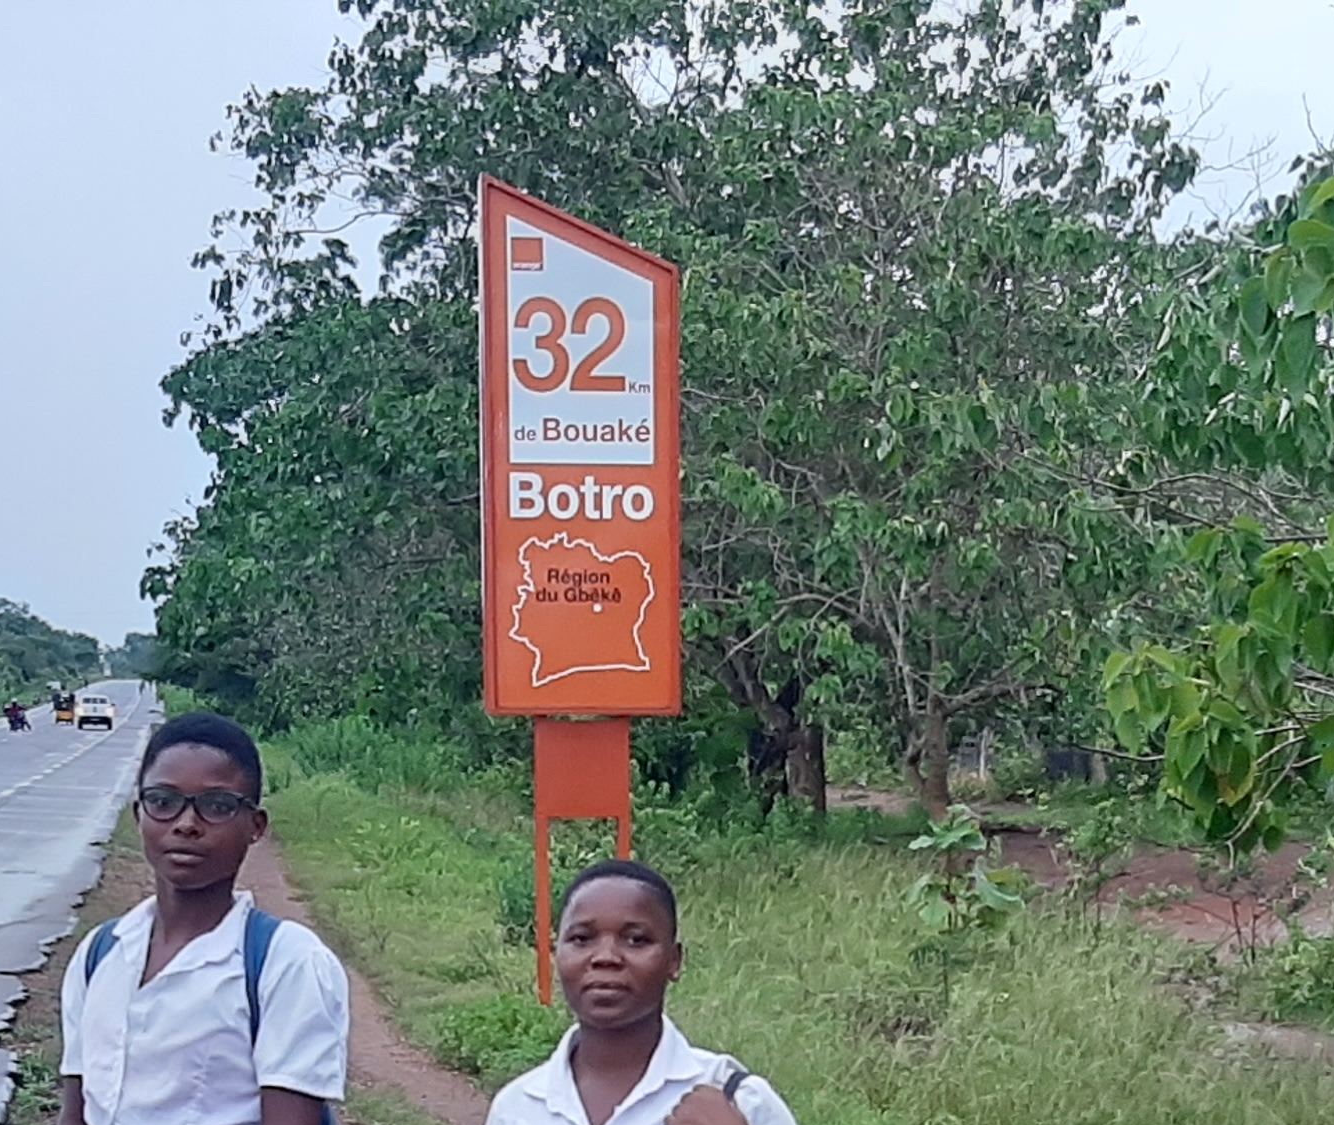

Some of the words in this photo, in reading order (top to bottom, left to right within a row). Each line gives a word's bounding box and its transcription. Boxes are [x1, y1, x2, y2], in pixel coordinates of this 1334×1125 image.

[512, 296, 626, 393] 32
[628, 382, 651, 393] Km
[514, 425, 537, 441] de
[542, 417, 651, 442] Bouaké
[509, 472, 654, 519] Botro
[547, 568, 610, 587] Région
[535, 587, 558, 602] du
